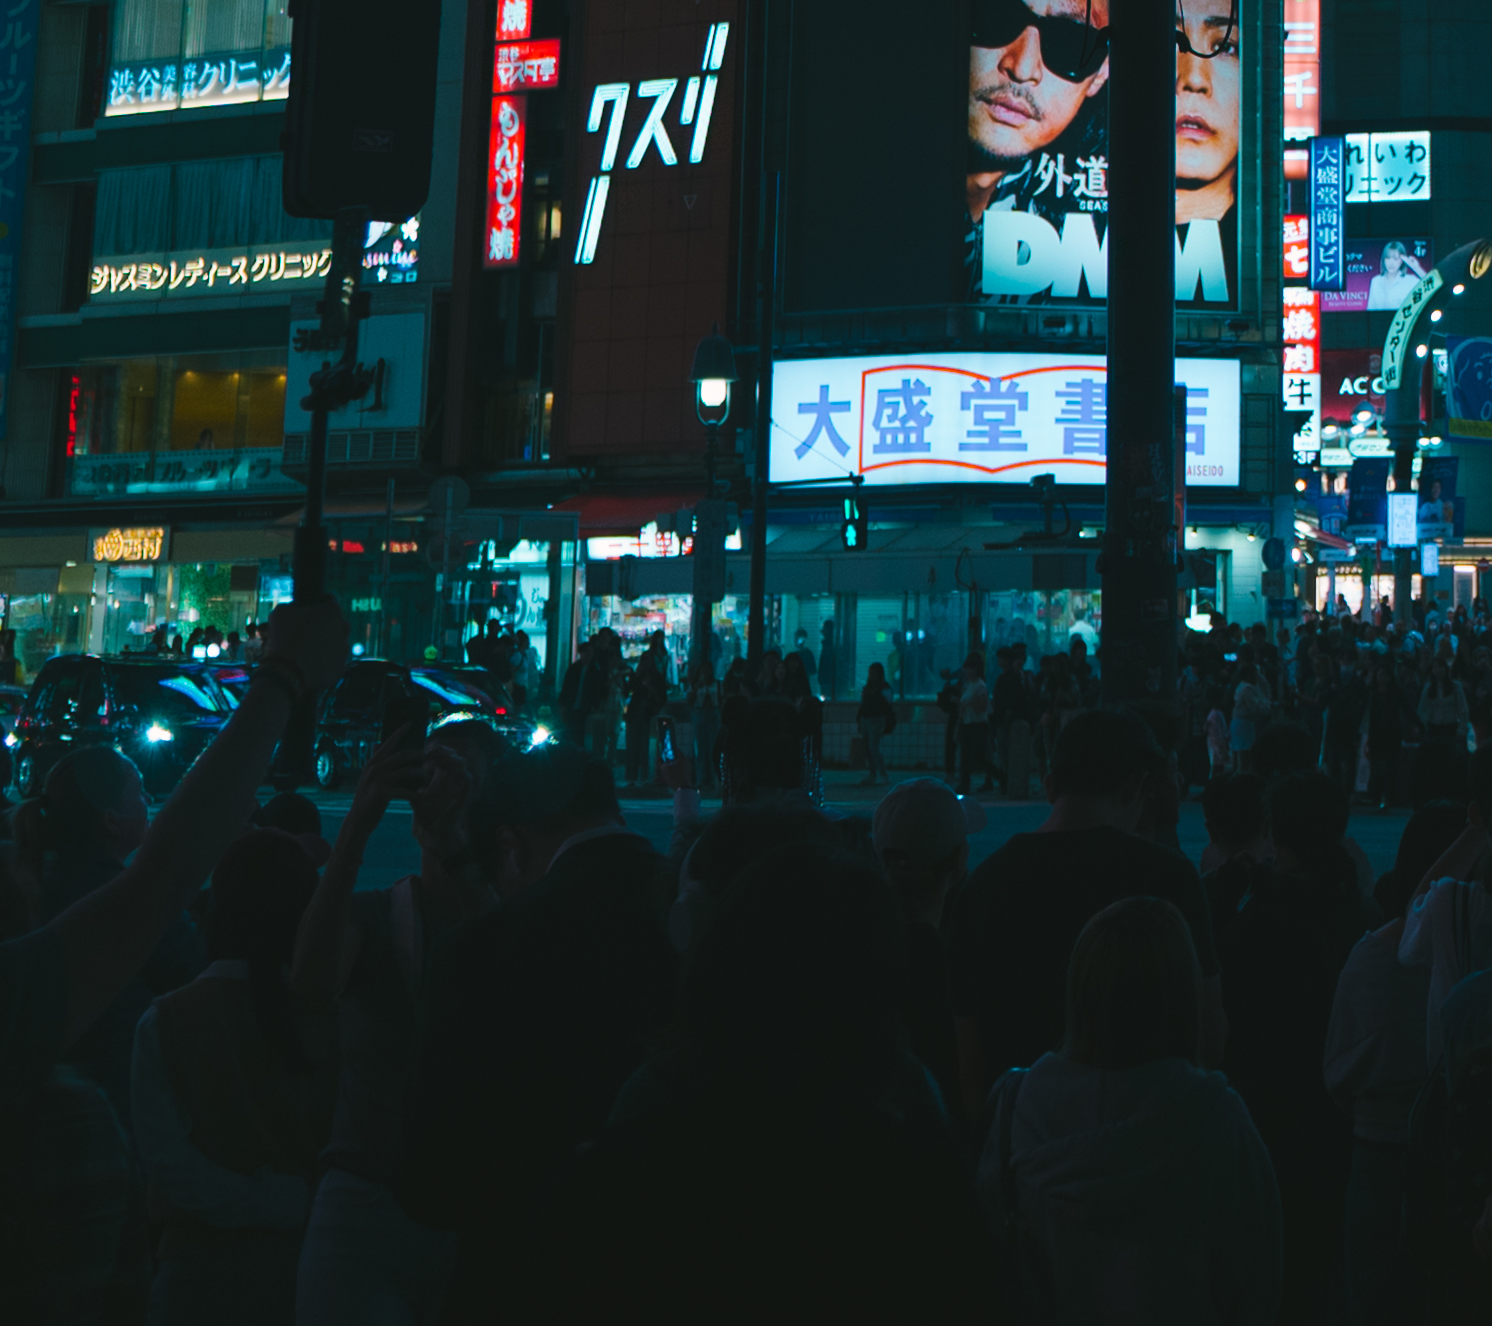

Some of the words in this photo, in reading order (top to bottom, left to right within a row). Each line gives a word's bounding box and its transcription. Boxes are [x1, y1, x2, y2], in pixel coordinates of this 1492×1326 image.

[1315, 145, 1340, 284] 大盛堂商事ビル
